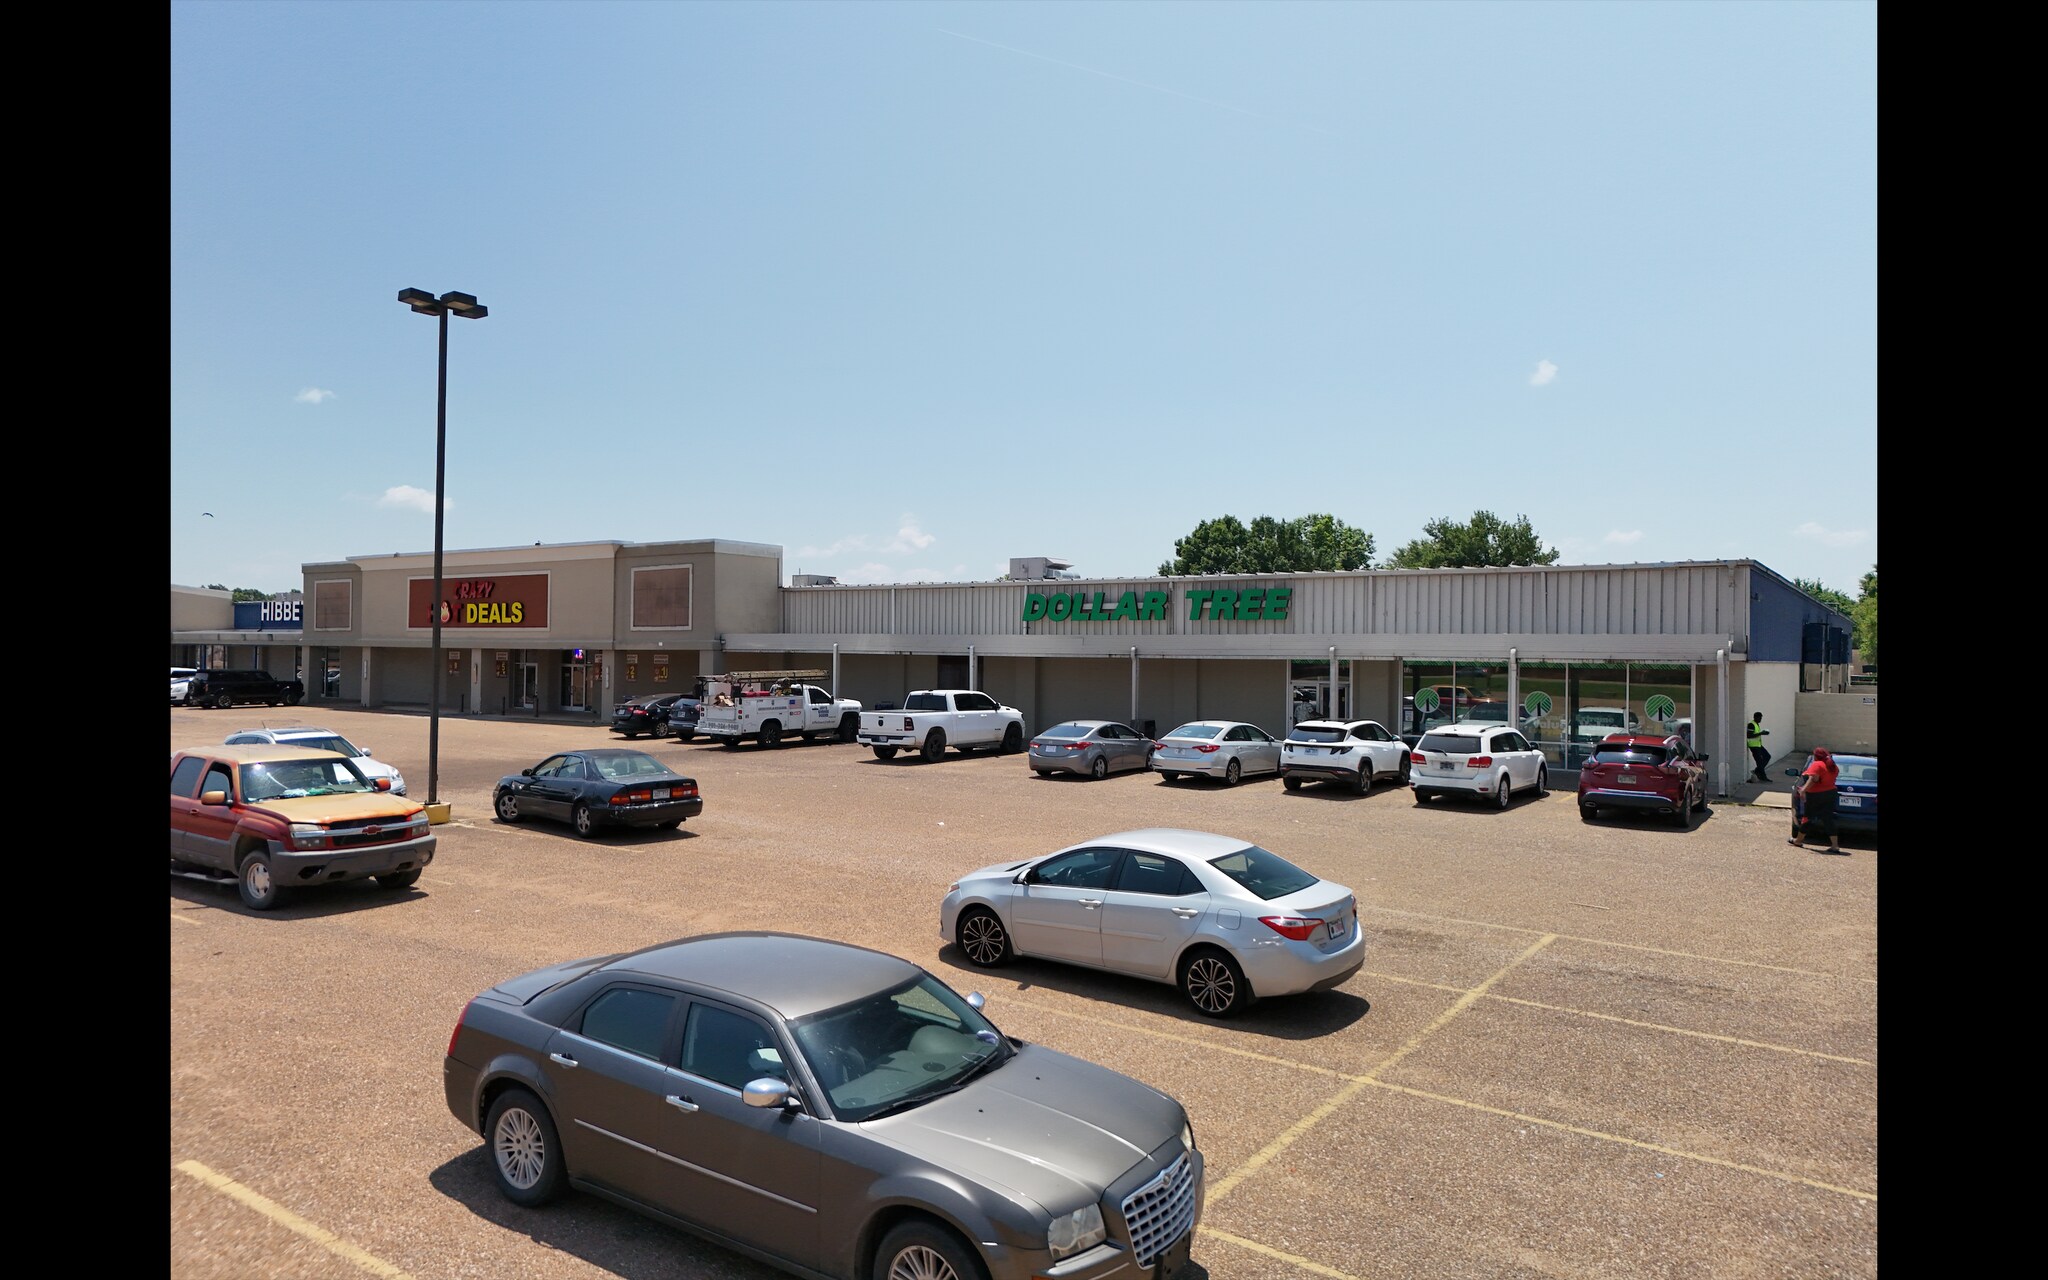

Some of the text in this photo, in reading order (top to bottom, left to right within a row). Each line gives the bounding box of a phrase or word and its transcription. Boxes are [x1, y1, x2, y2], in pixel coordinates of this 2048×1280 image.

[455, 582, 494, 600] CRAZY
[261, 600, 304, 621] HIBBE
[467, 602, 523, 623] DEALS
[1022, 588, 1292, 622] DOLLAR TREE
